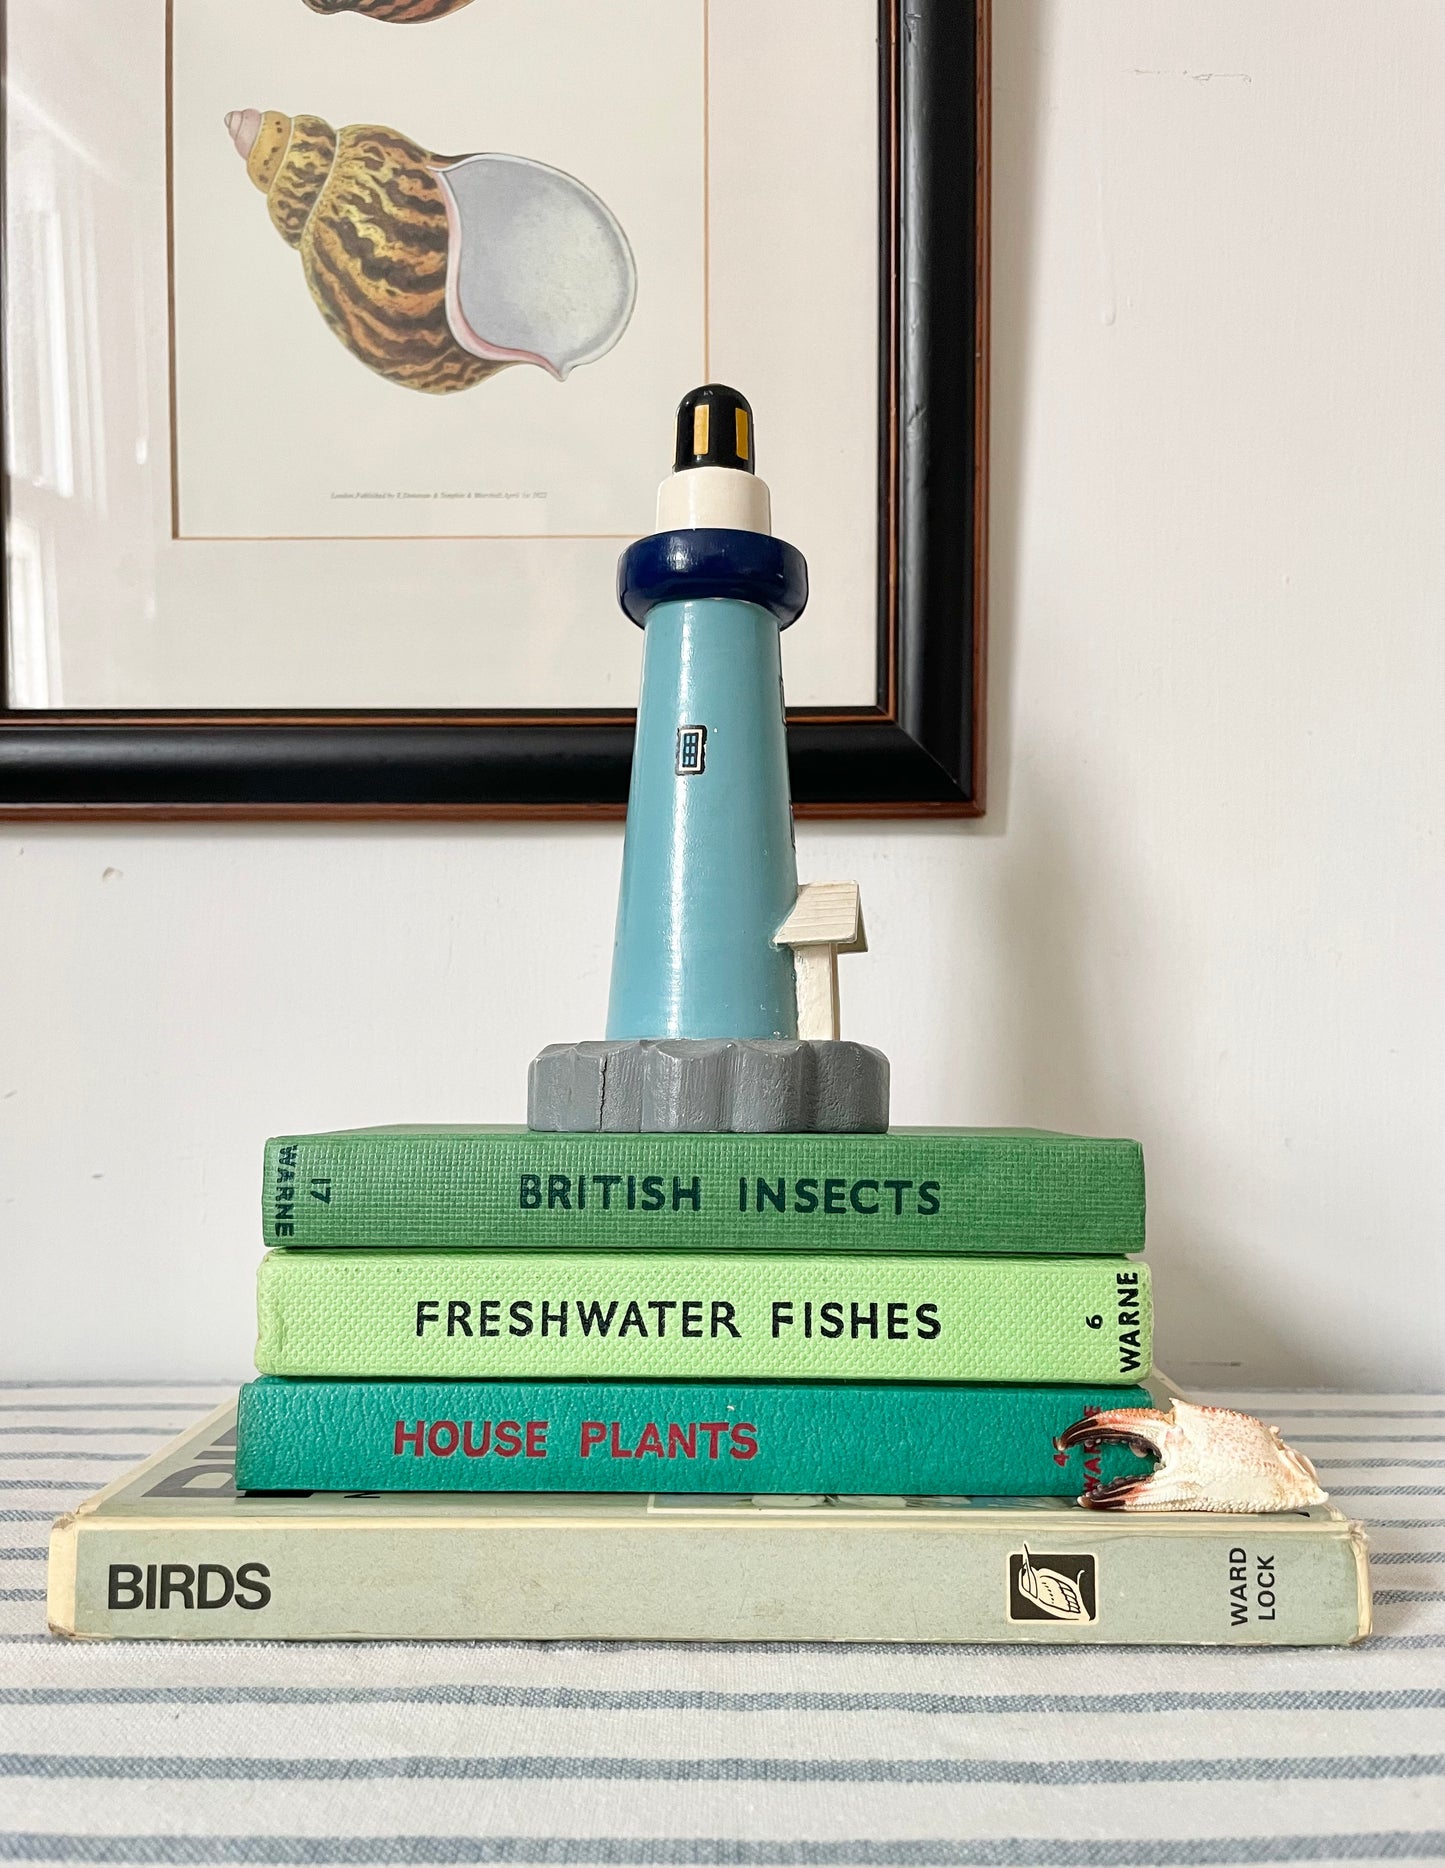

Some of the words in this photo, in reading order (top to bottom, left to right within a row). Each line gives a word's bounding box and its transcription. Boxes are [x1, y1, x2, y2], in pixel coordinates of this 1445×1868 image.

[275, 1144, 298, 1236] WARNE
[310, 1178, 331, 1204] 17
[519, 1174, 702, 1211] BRITISH
[739, 1177, 941, 1216] INSECTS
[416, 1300, 742, 1338] FRESHWATER
[771, 1301, 942, 1340] FISHES
[1085, 1314, 1103, 1330] 6
[1116, 1272, 1141, 1373] WARNE
[394, 1420, 548, 1458] HOUSE
[580, 1421, 759, 1460] PLANTS
[107, 1562, 272, 1611] BIRDS
[1229, 1547, 1248, 1627] WARD
[1257, 1555, 1276, 1621] LOCK
